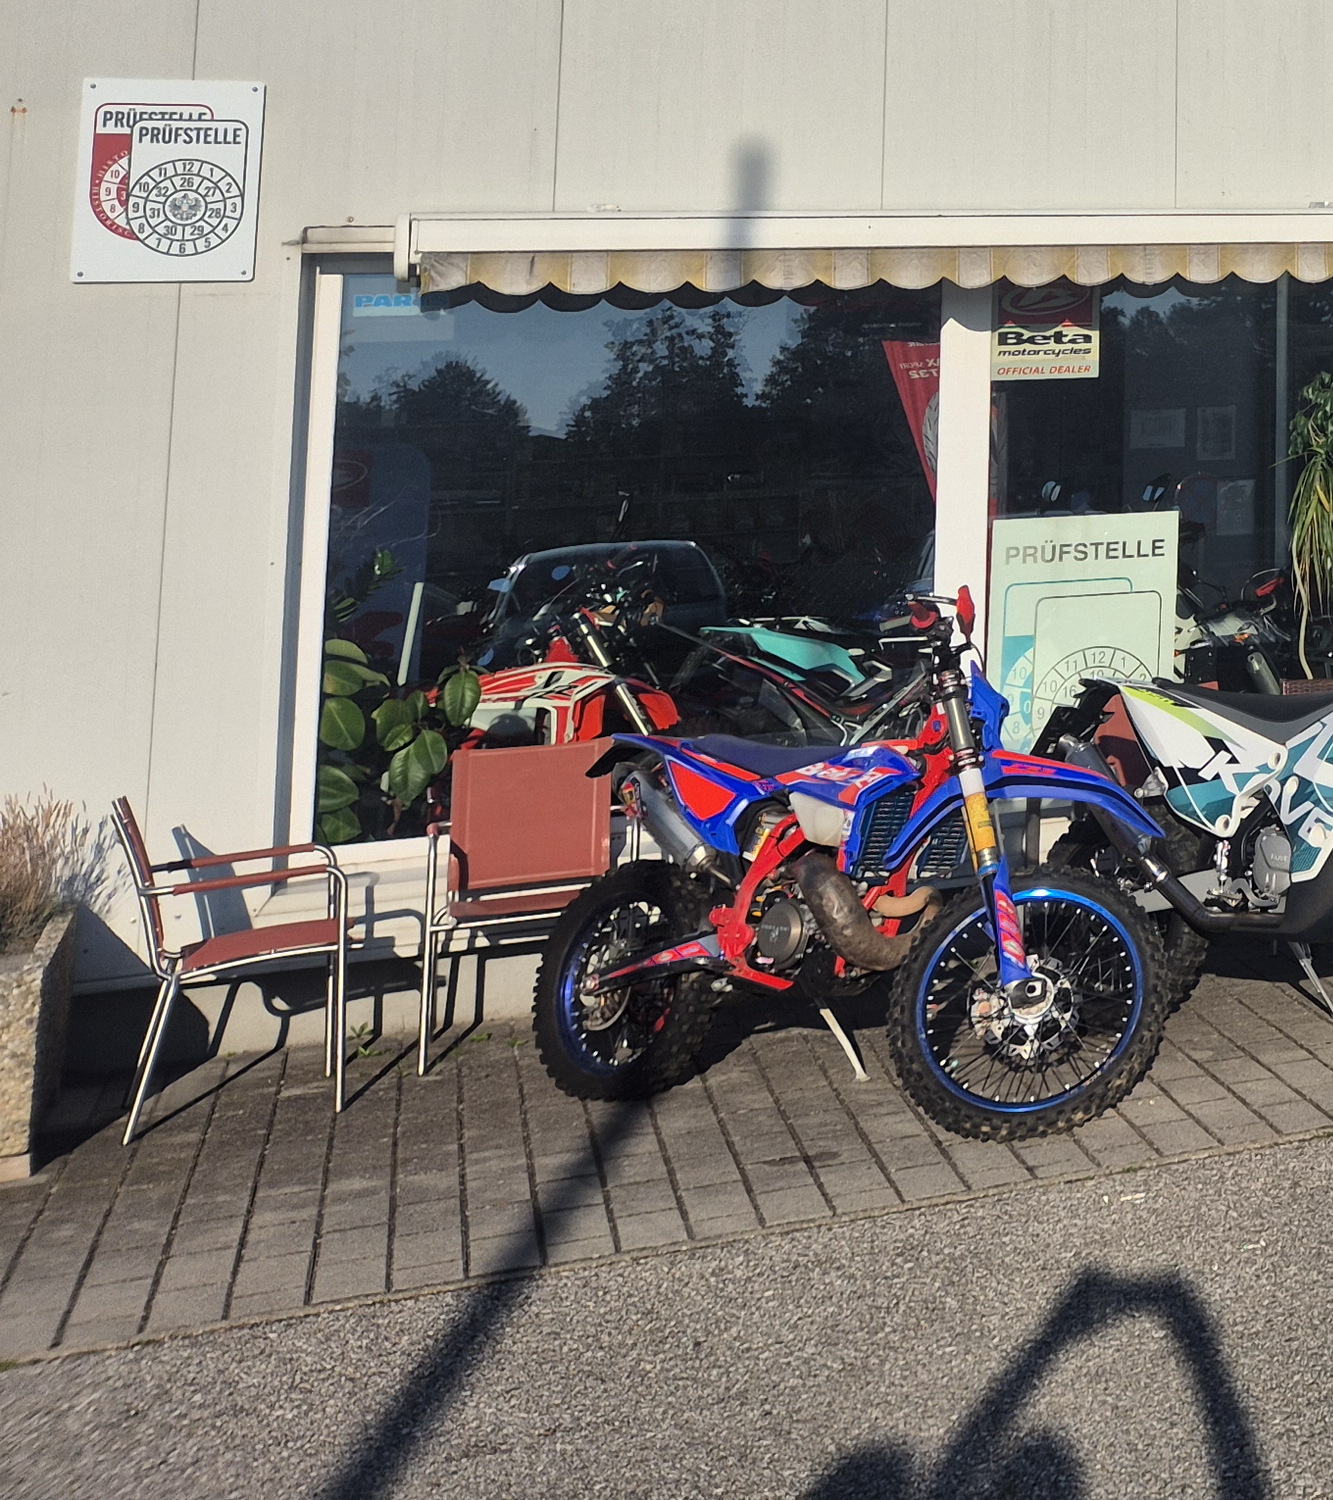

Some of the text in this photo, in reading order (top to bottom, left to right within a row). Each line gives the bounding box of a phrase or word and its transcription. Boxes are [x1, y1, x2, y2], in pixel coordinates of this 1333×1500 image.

[138, 123, 243, 145] PRÜFSTELLE
[158, 162, 214, 178] 11 12 1
[105, 187, 111, 196] 9
[138, 181, 150, 193] 10
[155, 176, 217, 198] 32 26 27
[225, 182, 233, 193] 2
[110, 204, 116, 213] 8
[132, 202, 140, 213] 9
[149, 207, 221, 219] 31 28
[230, 202, 237, 213] 3
[138, 222, 145, 233] 8
[163, 225, 204, 236] 30 29
[221, 222, 229, 234] 4
[155, 237, 211, 254] 7 6 5
[997, 331, 1093, 346] Beta
[997, 347, 1092, 357] motorcycles
[997, 365, 1092, 376] OFFICIAL DEALER
[1004, 539, 1166, 565] PRÜFSTELLE
[1012, 667, 1027, 680] 10
[1043, 680, 1057, 693] 10
[1064, 659, 1079, 672] 11
[1091, 651, 1106, 664] 12
[1121, 656, 1126, 668] 1
[1063, 685, 1077, 698] 16
[1037, 707, 1045, 720] 9
